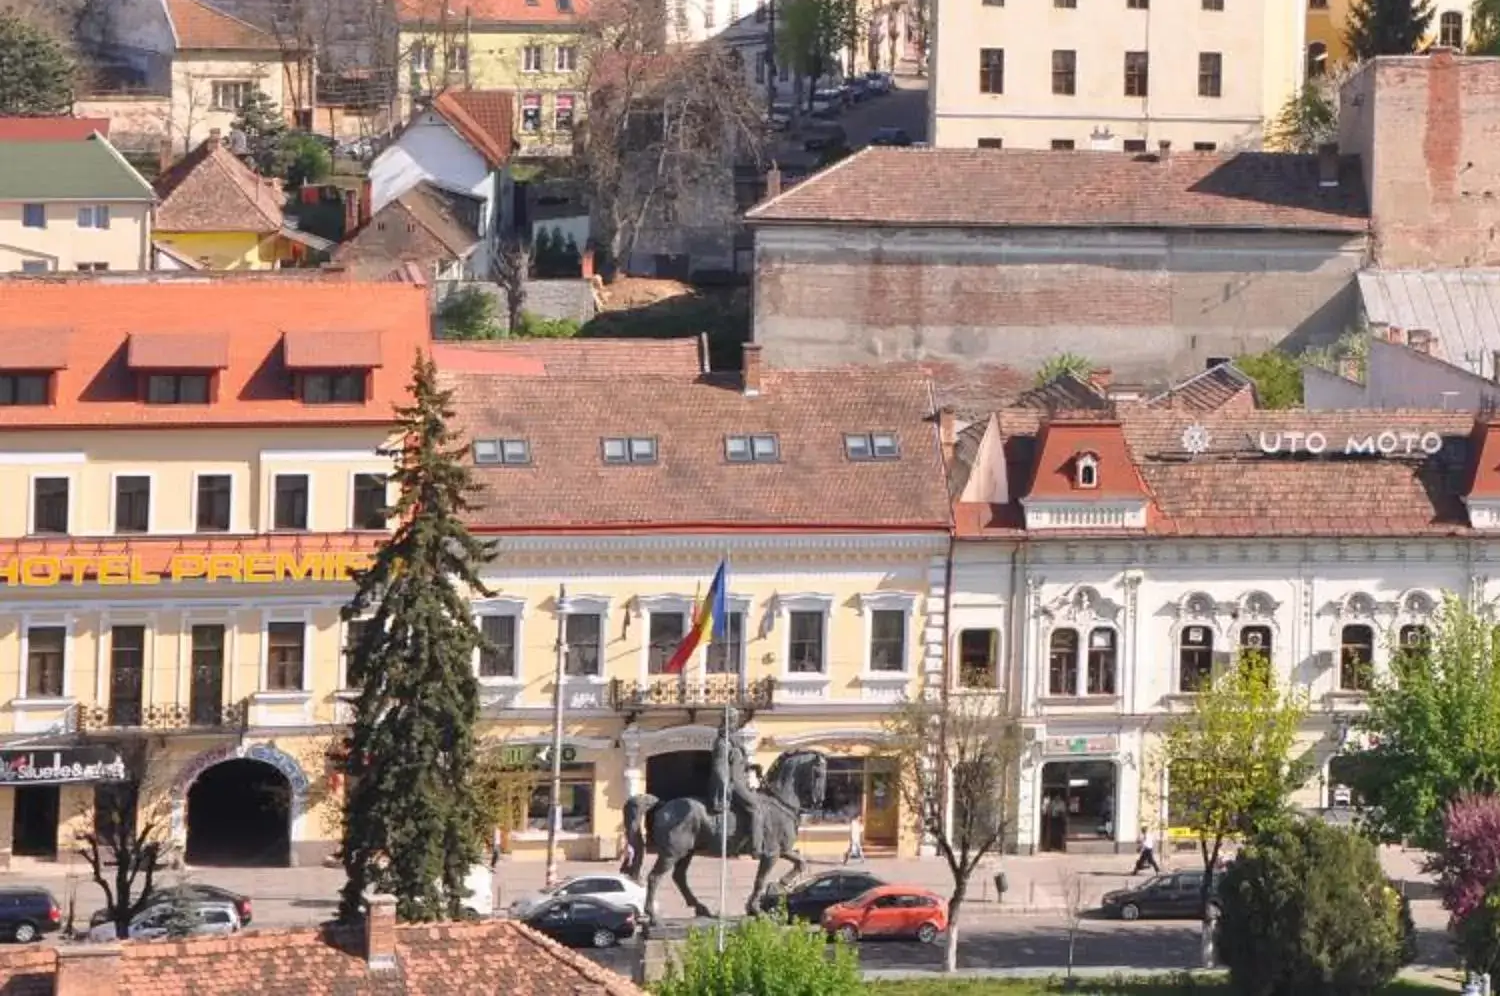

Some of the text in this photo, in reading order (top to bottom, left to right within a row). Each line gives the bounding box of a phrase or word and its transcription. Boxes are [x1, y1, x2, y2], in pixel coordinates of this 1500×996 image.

[1259, 431, 1443, 455] UTO MOTO
[171, 551, 408, 584] PREMIE
